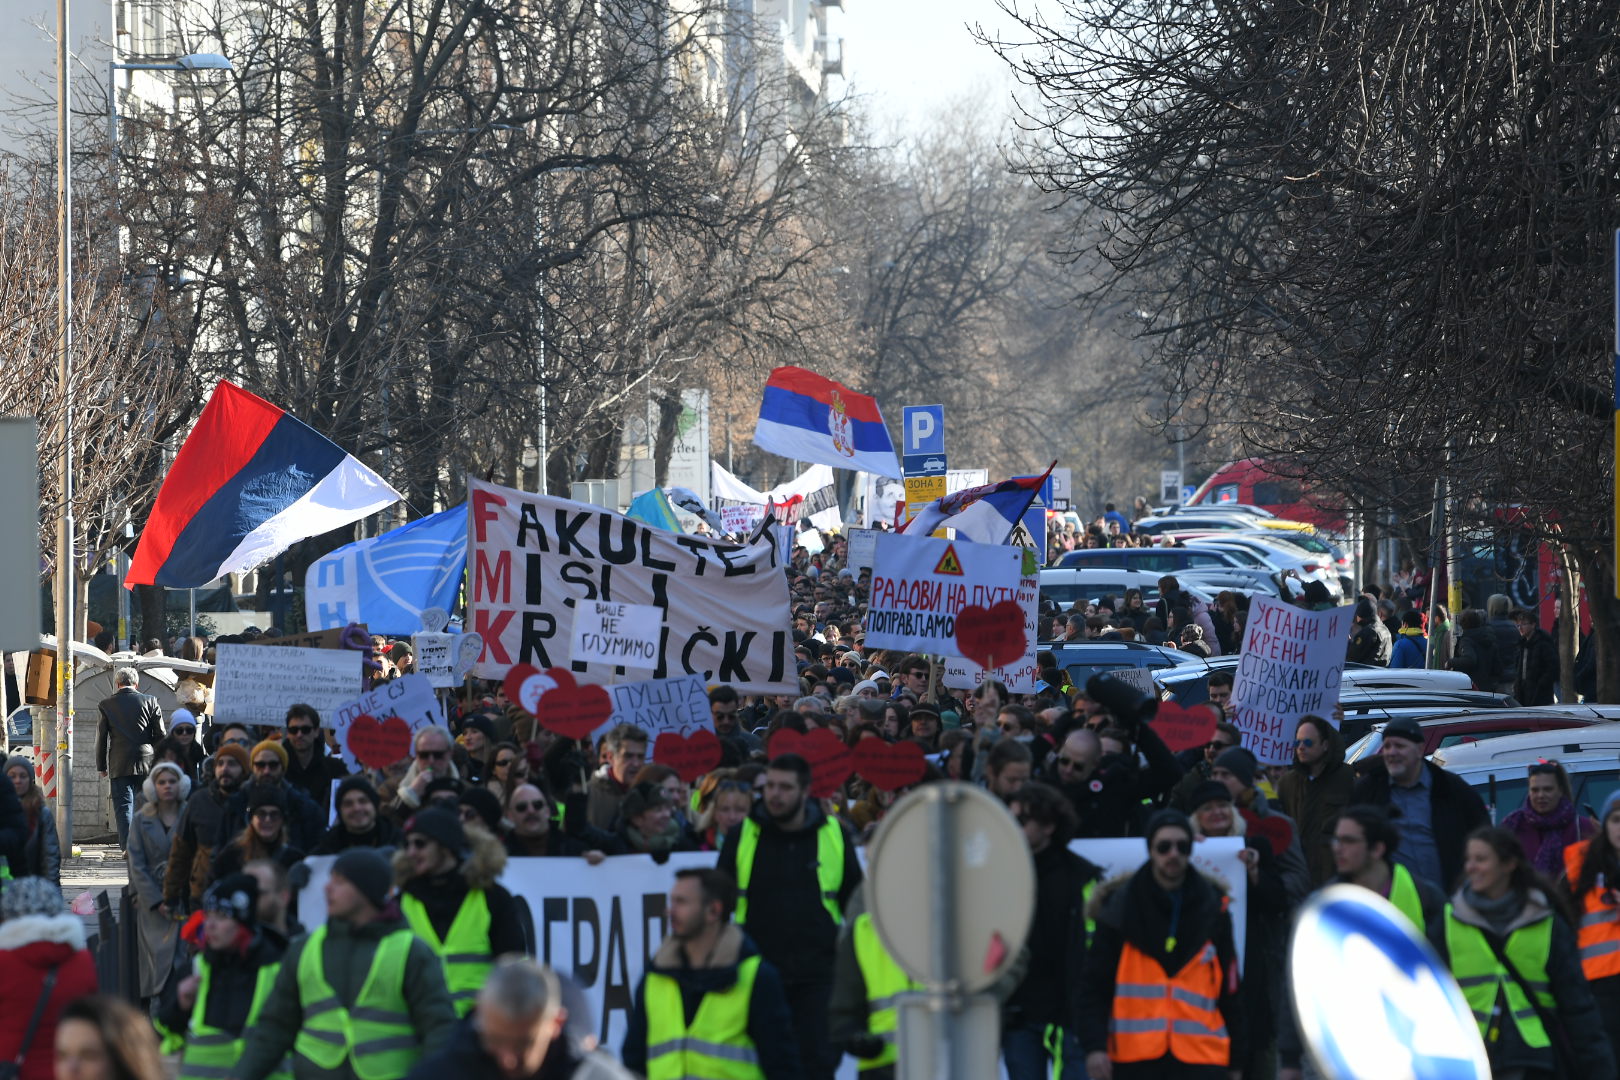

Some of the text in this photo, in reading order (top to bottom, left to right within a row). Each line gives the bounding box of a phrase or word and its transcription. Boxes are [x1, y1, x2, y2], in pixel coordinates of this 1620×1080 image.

[912, 411, 934, 450] P
[908, 478, 943, 489] ЗОНА 2
[472, 489, 777, 577] FAKULTET
[595, 602, 626, 617] ВИШЕ
[872, 577, 943, 613] РАДОВИ
[947, 583, 967, 615] НА
[602, 618, 621, 634] НЕ
[867, 610, 955, 639] ПОПРАВЉАМО
[1253, 602, 1338, 640] УСТАНИ И
[475, 609, 786, 682] KRIČKI
[582, 633, 655, 659] ГЛУМИМО
[1249, 628, 1307, 664] КРЕНИ
[1242, 652, 1344, 690] СТРАЖАРИ СУ
[338, 692, 383, 727] ЛОШЕ
[388, 682, 405, 700] СУ
[614, 679, 708, 712] ПУШТА
[676, 701, 708, 723] СЕ
[1237, 681, 1323, 713] ОТРОВАНИ
[1231, 705, 1284, 738] КОЊИ
[1240, 733, 1295, 760] ПРЕМН
